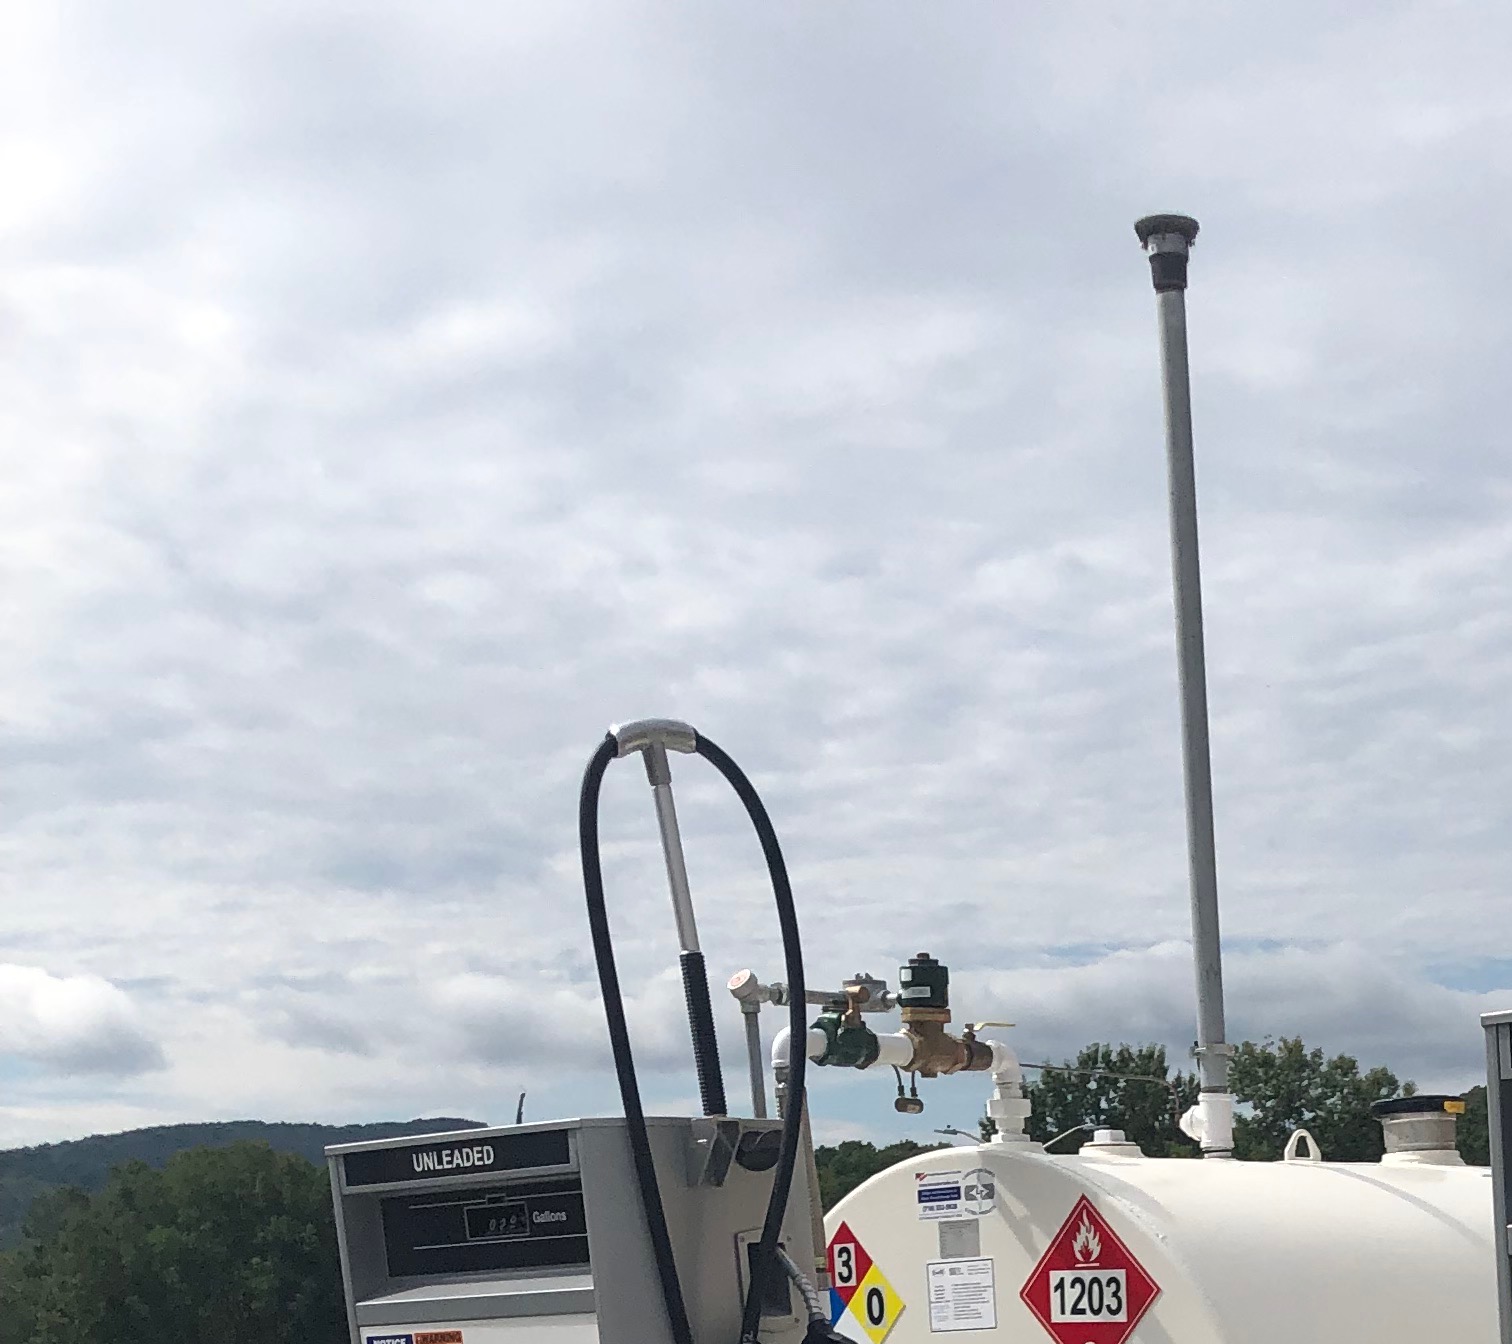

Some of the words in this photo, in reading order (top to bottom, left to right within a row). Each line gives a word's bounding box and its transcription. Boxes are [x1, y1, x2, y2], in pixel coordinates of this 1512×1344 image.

[412, 1145, 495, 1172] UNLEADED
[532, 1211, 567, 1223] Gallons
[837, 1246, 853, 1284] 3
[866, 1286, 885, 1326] 0
[1053, 1276, 1123, 1316] 1203
